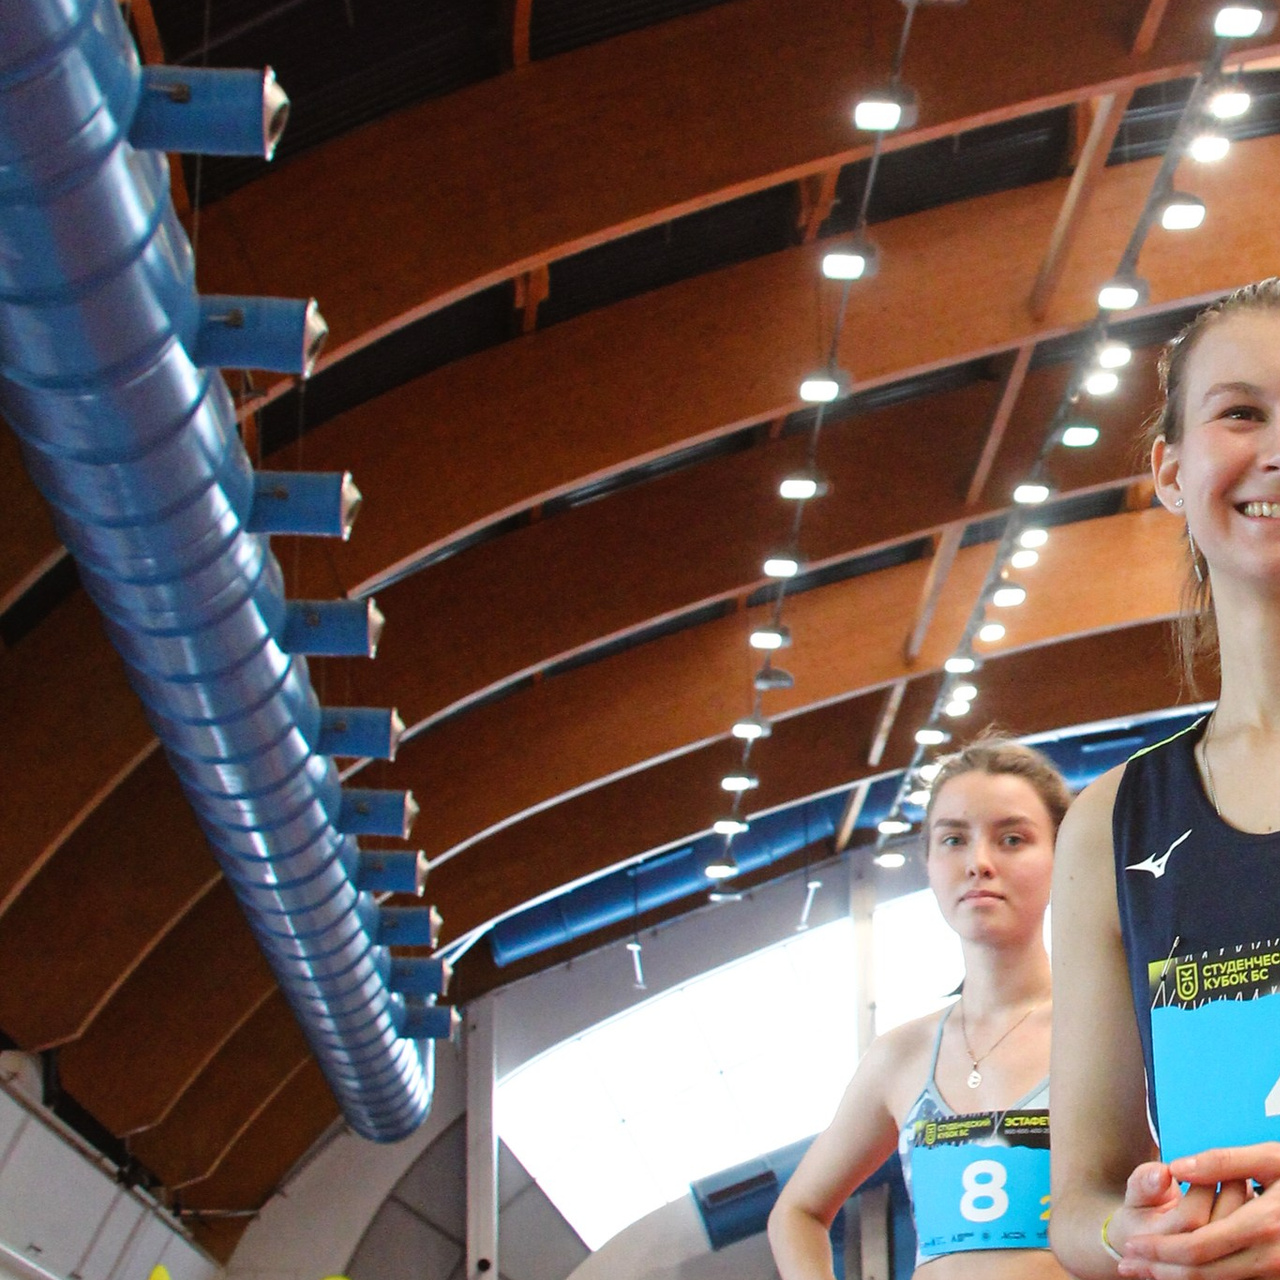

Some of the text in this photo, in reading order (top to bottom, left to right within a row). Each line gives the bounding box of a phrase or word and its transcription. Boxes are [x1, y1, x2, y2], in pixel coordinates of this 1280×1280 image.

[1203, 968, 1269, 991] КУБОК БС
[961, 1160, 1008, 1222] 8
